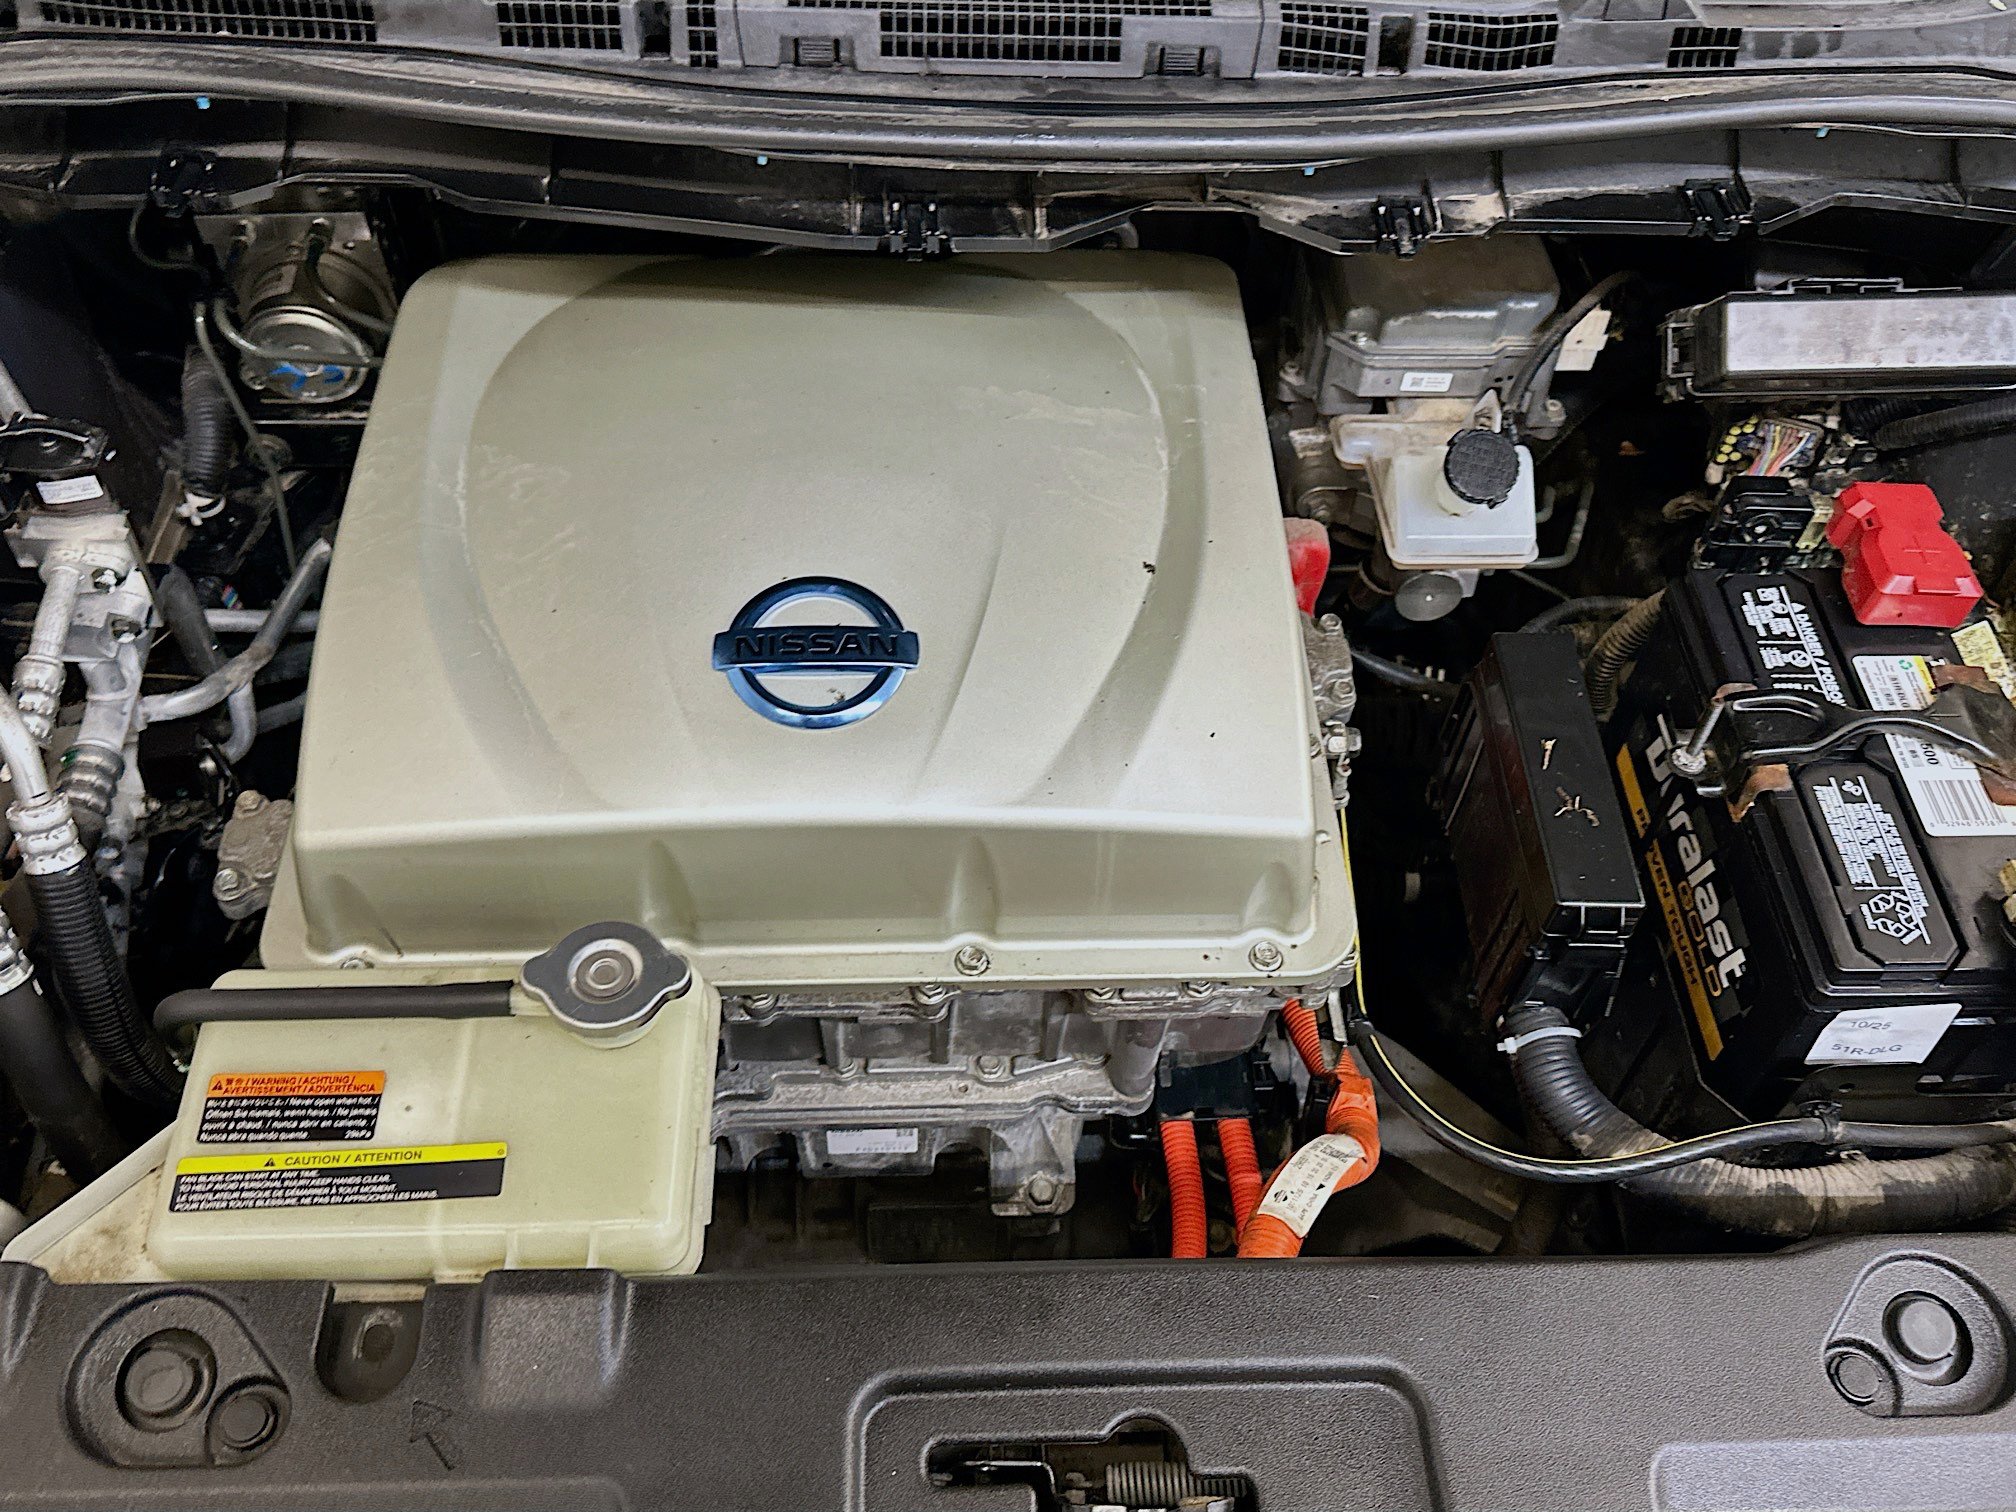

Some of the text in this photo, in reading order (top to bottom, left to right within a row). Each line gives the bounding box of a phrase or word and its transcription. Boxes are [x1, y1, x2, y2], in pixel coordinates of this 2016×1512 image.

[1796, 613, 1825, 657] DANGER
[735, 631, 898, 659] NISSAN
[1920, 743, 1940, 765] 500
[1635, 808, 1698, 986] PVEN TOUGH
[1676, 880, 1723, 998] GOLD
[1850, 1021, 1893, 1030] 10/25
[1831, 1043, 1904, 1056] 51R-DLG
[251, 1077, 297, 1086] WARNING
[303, 1075, 350, 1085] ACHTUNG
[222, 1085, 302, 1095] AVERTISSEMENT
[289, 1097, 315, 1107] Never
[314, 1098, 336, 1107] open
[335, 1097, 358, 1106] when
[284, 1154, 340, 1166] CAUTION
[353, 1150, 423, 1163] ATTENTION
